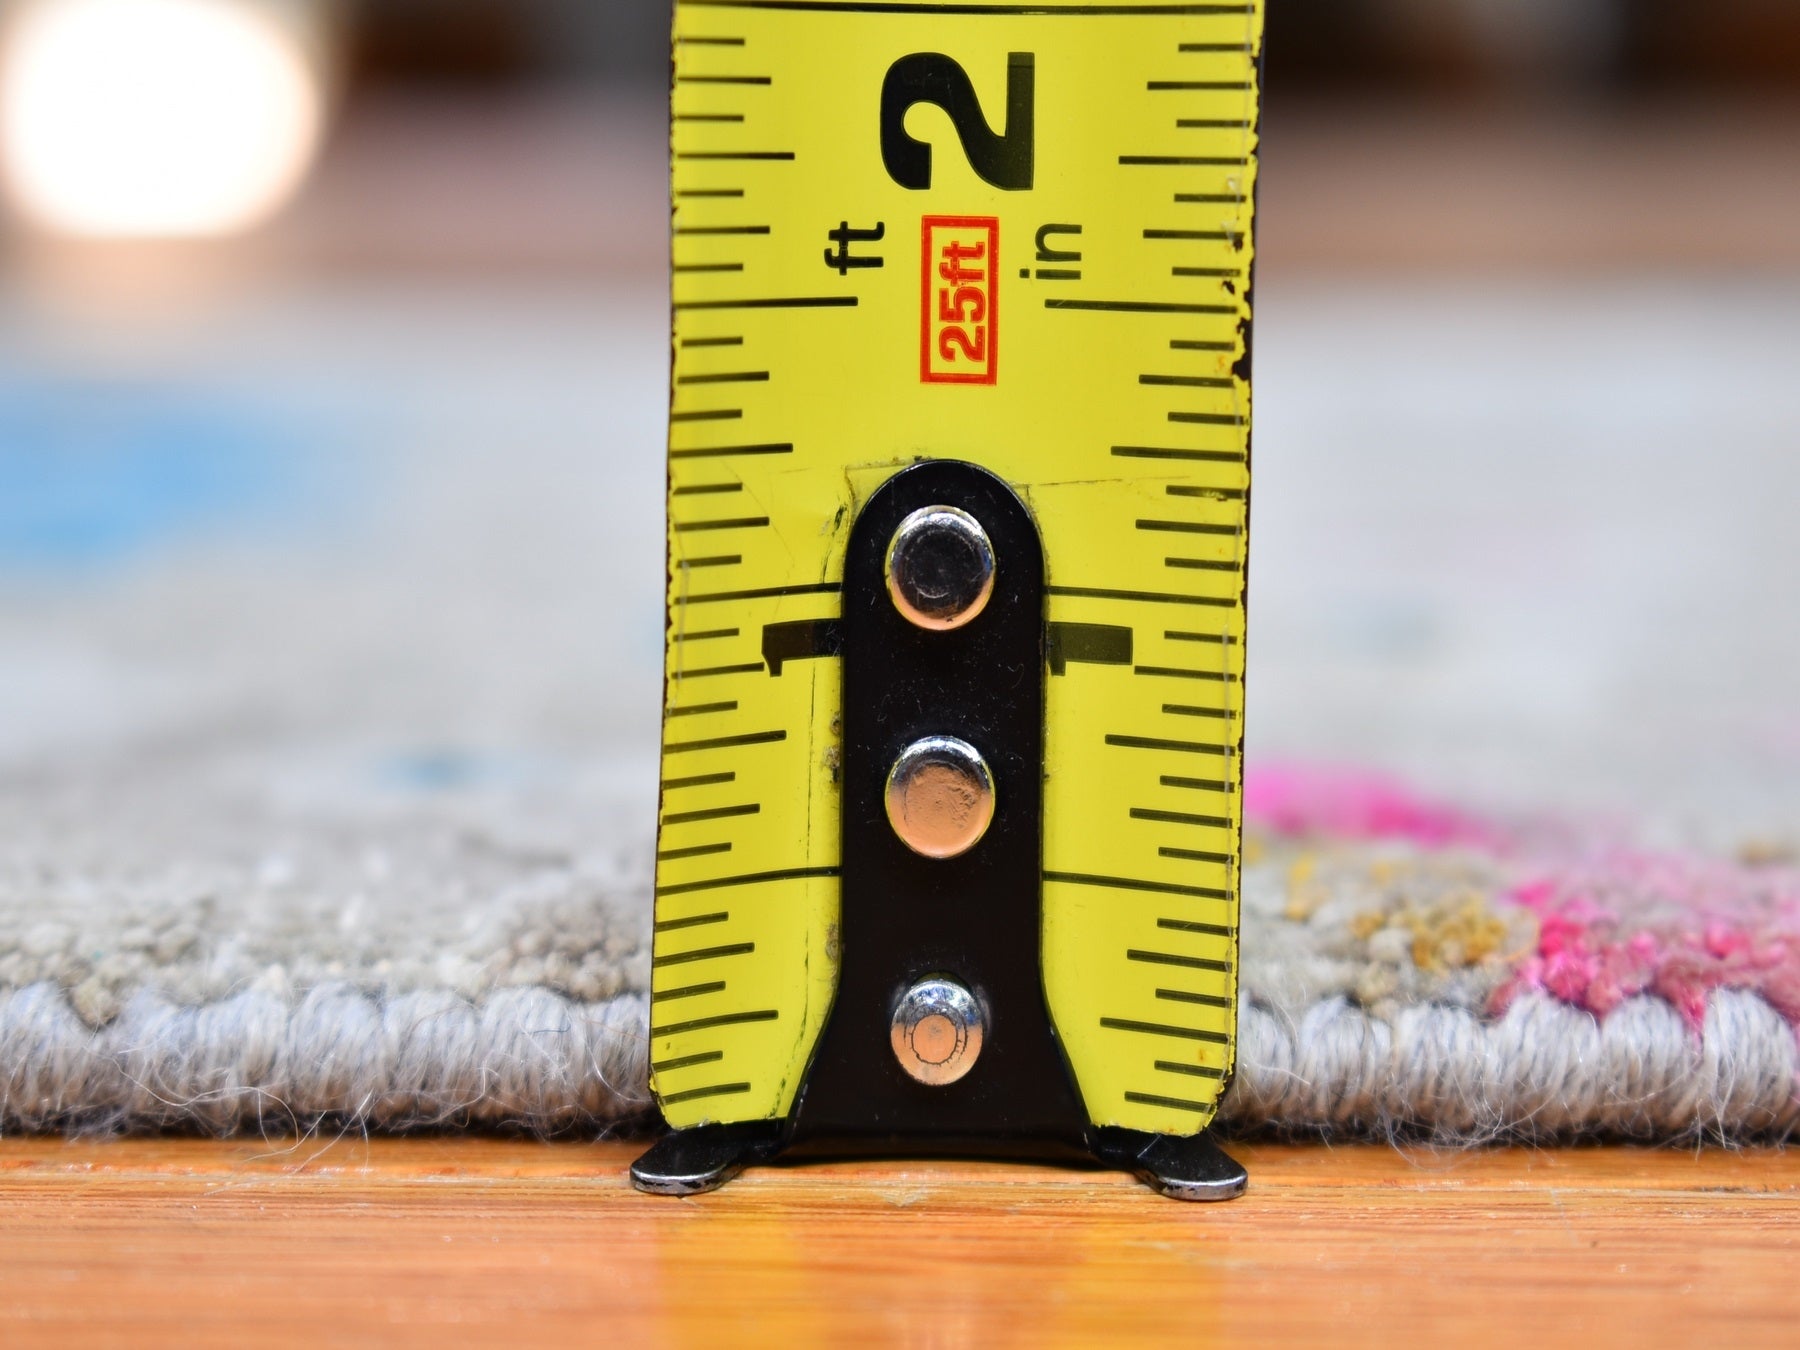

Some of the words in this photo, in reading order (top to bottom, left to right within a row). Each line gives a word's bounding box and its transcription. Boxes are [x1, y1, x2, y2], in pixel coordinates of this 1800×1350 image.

[880, 51, 1035, 191] 2
[824, 220, 885, 276] ft
[1019, 223, 1082, 280] in
[938, 240, 986, 362] 25ft
